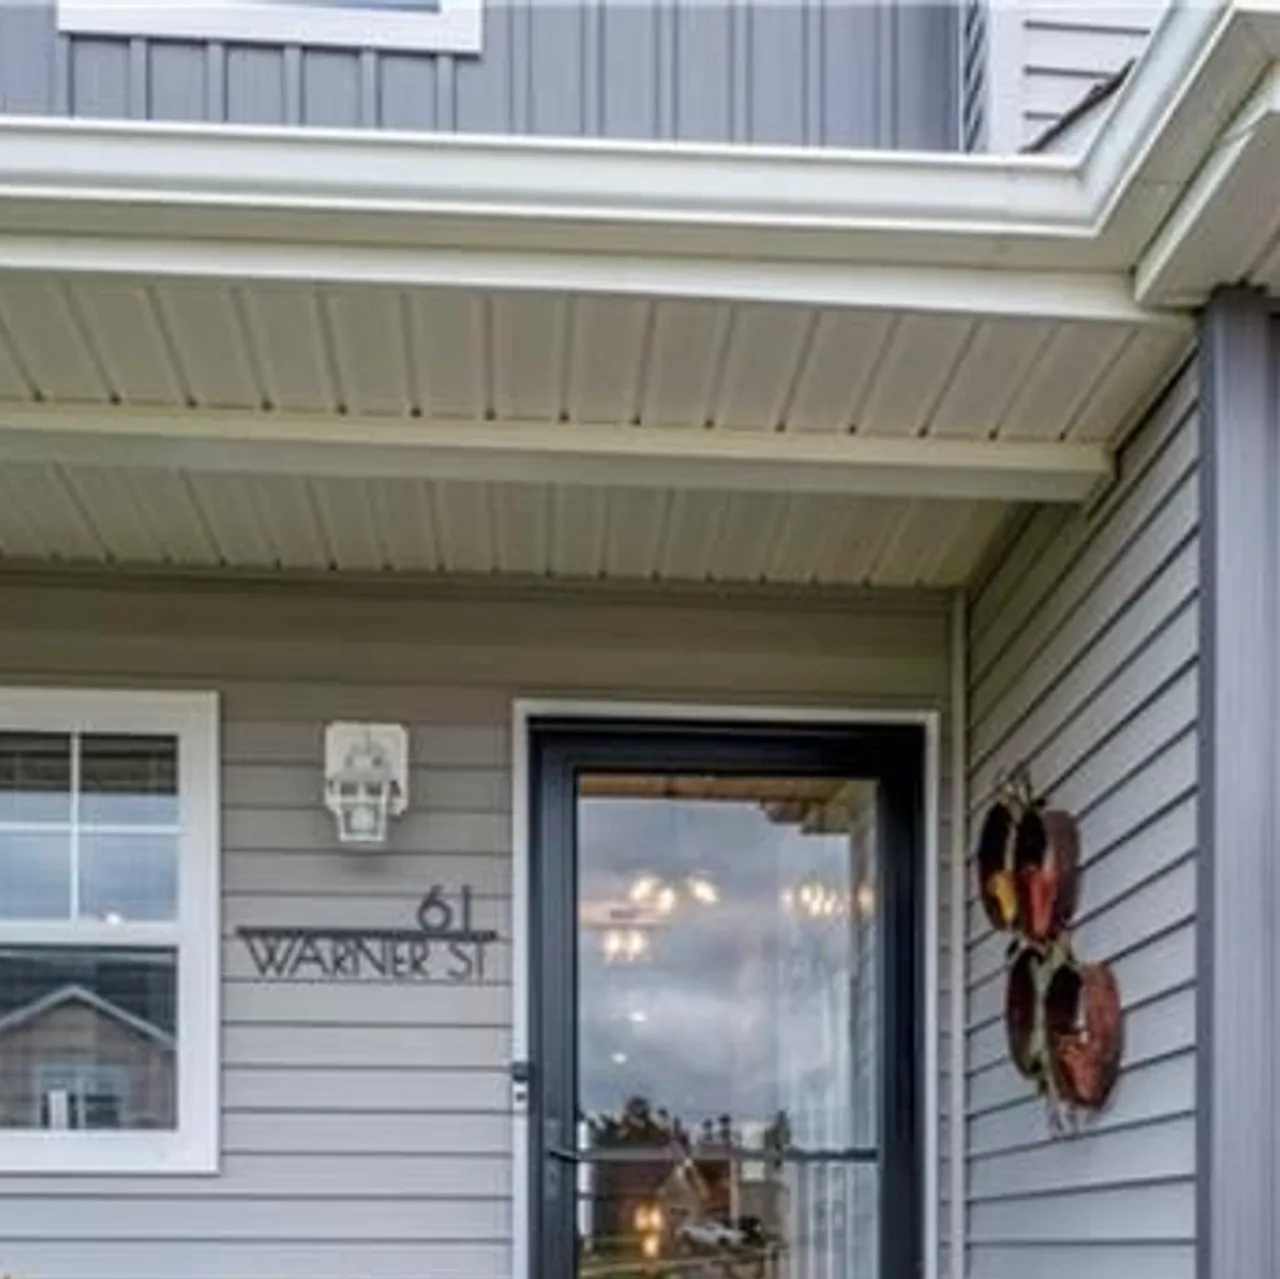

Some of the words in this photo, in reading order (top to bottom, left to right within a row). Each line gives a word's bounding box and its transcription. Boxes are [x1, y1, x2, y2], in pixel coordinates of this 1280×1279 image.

[417, 885, 472, 934] 61
[242, 934, 431, 980] WARNER
[447, 938, 488, 982] ST
